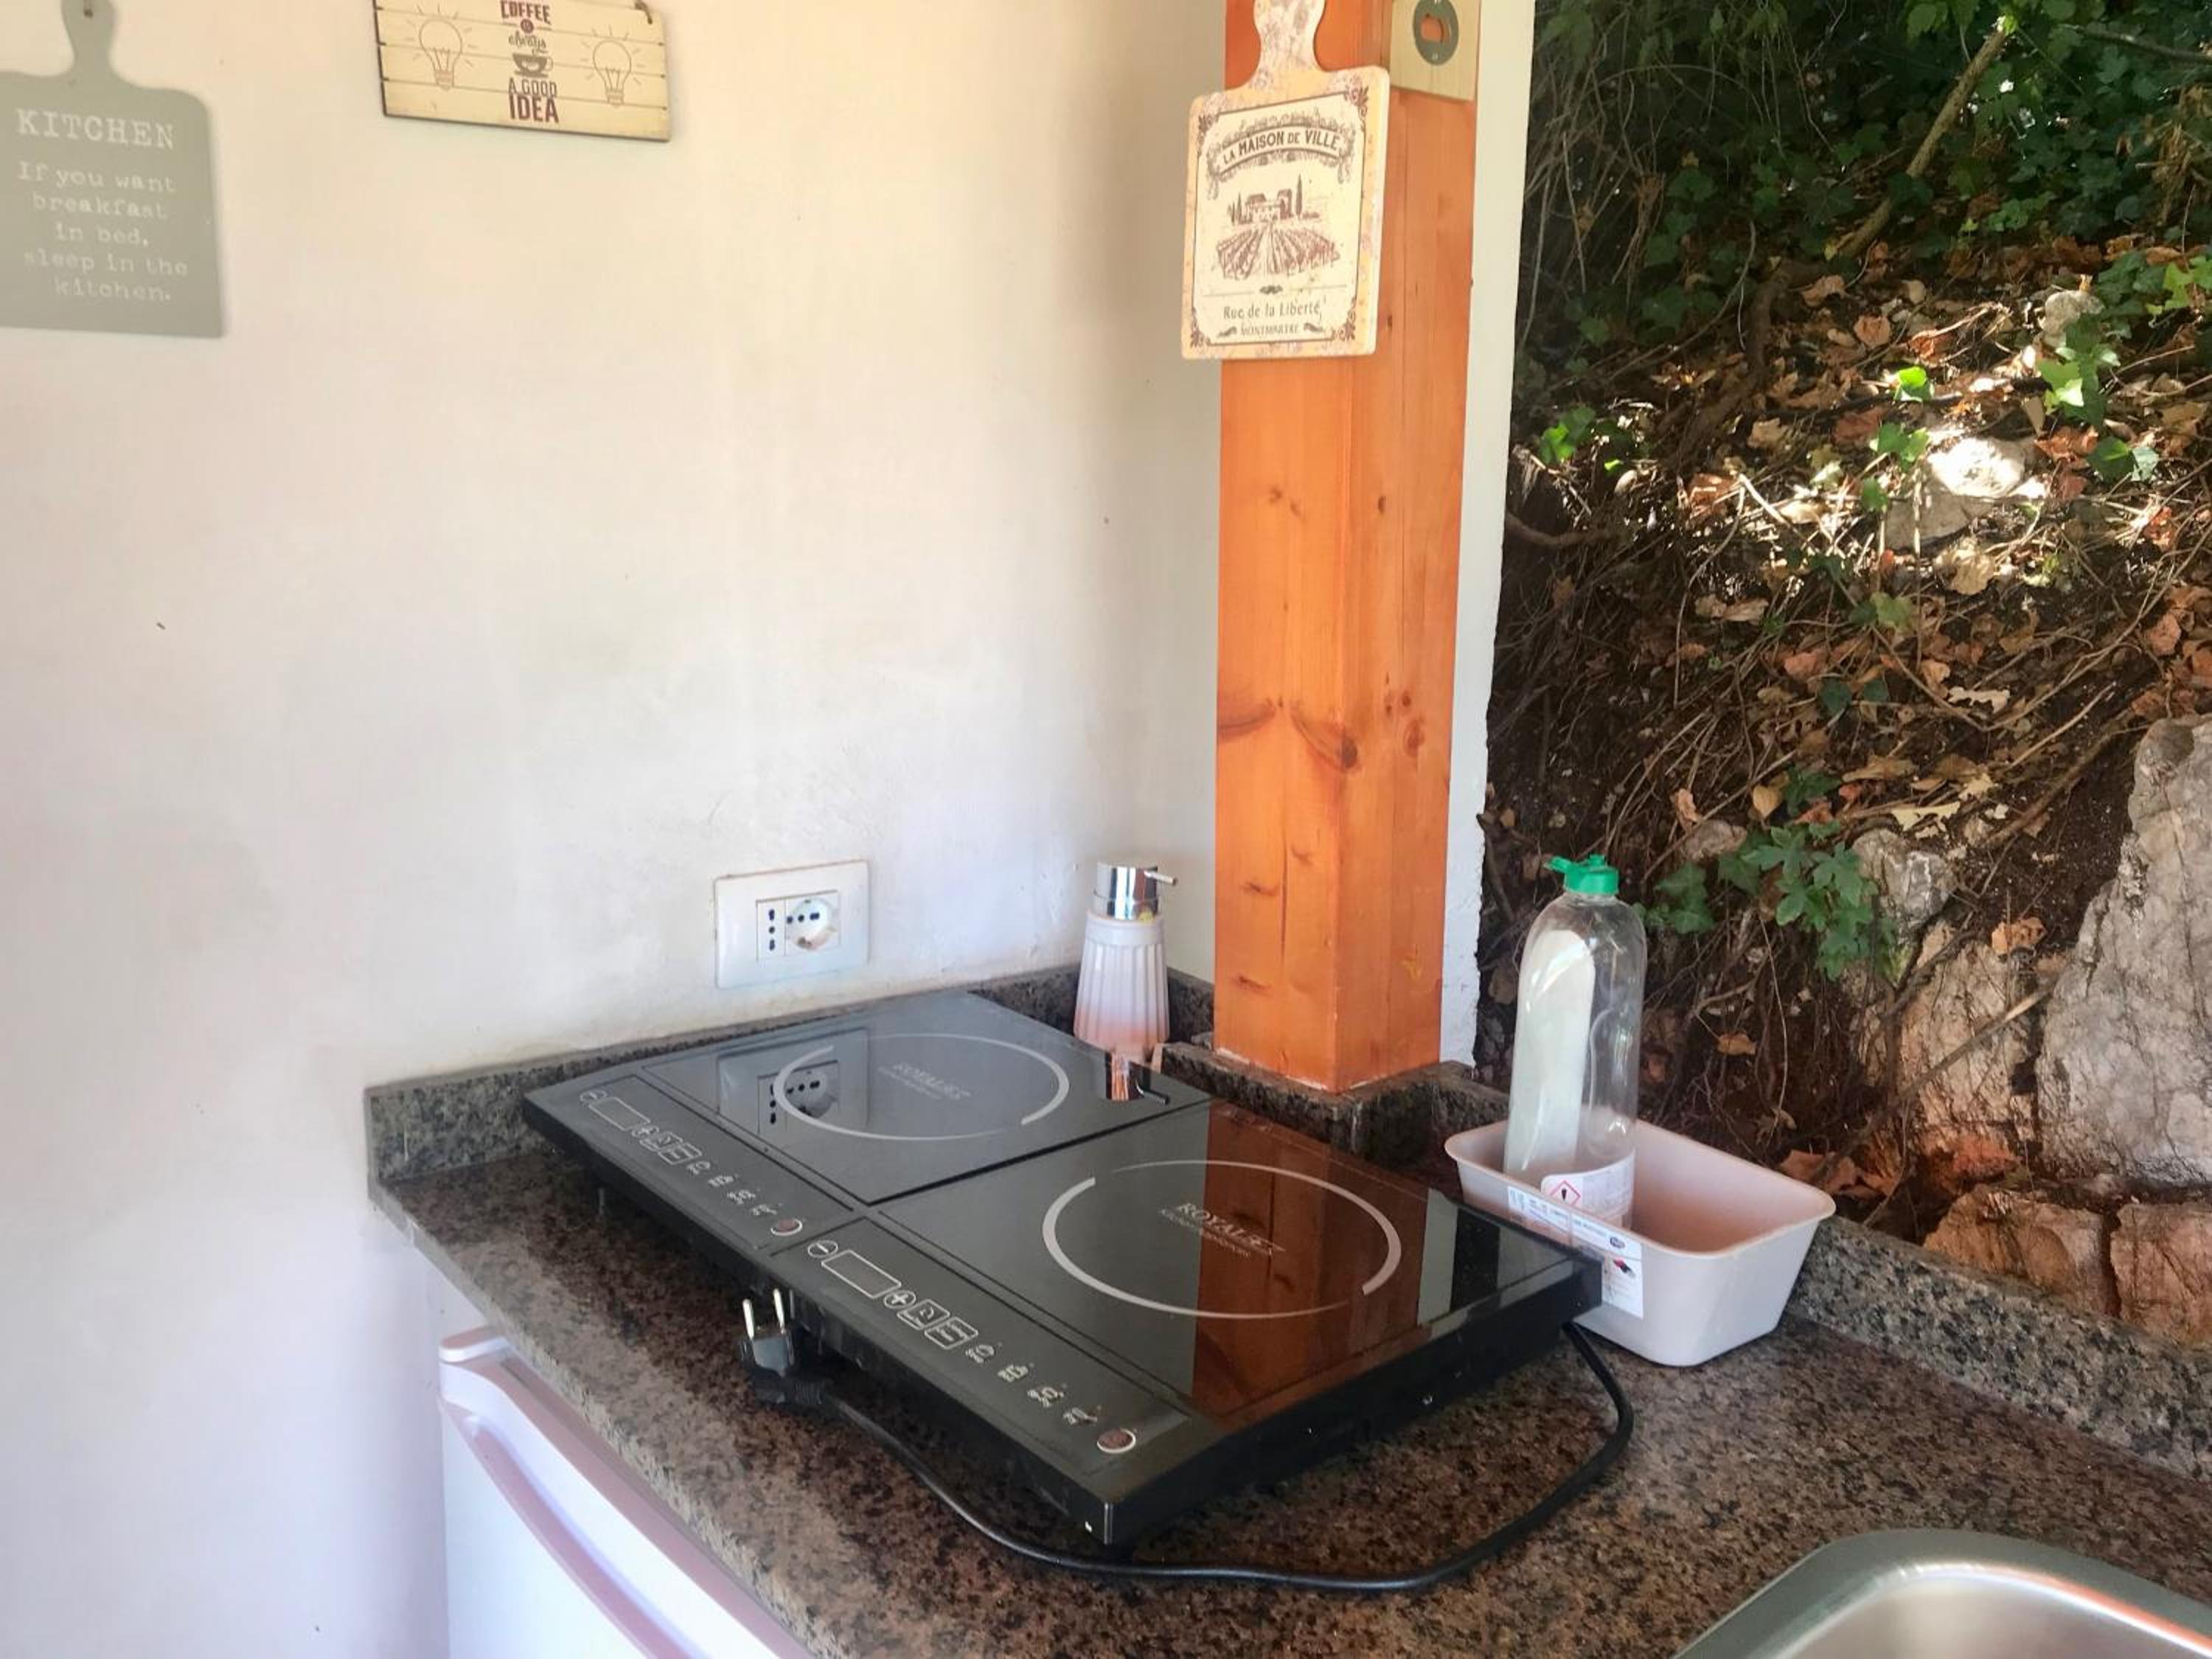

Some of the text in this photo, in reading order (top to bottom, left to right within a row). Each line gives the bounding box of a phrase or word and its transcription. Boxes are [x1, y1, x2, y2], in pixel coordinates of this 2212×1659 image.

[500, 0, 552, 24] COFFEE
[508, 77, 557, 98] A GOOD
[509, 94, 560, 124] IDEA
[15, 107, 175, 150] KITCHEN
[1222, 130, 1340, 164] LA MAISON DE VILLE
[18, 161, 175, 192] If you want
[32, 190, 169, 220] breakfast
[55, 222, 148, 246] in bed,
[23, 248, 188, 276] sleep in the
[54, 276, 171, 301] kitchen.
[1222, 306, 1245, 319] Rue
[1248, 302, 1260, 318] de
[1265, 301, 1276, 317] la
